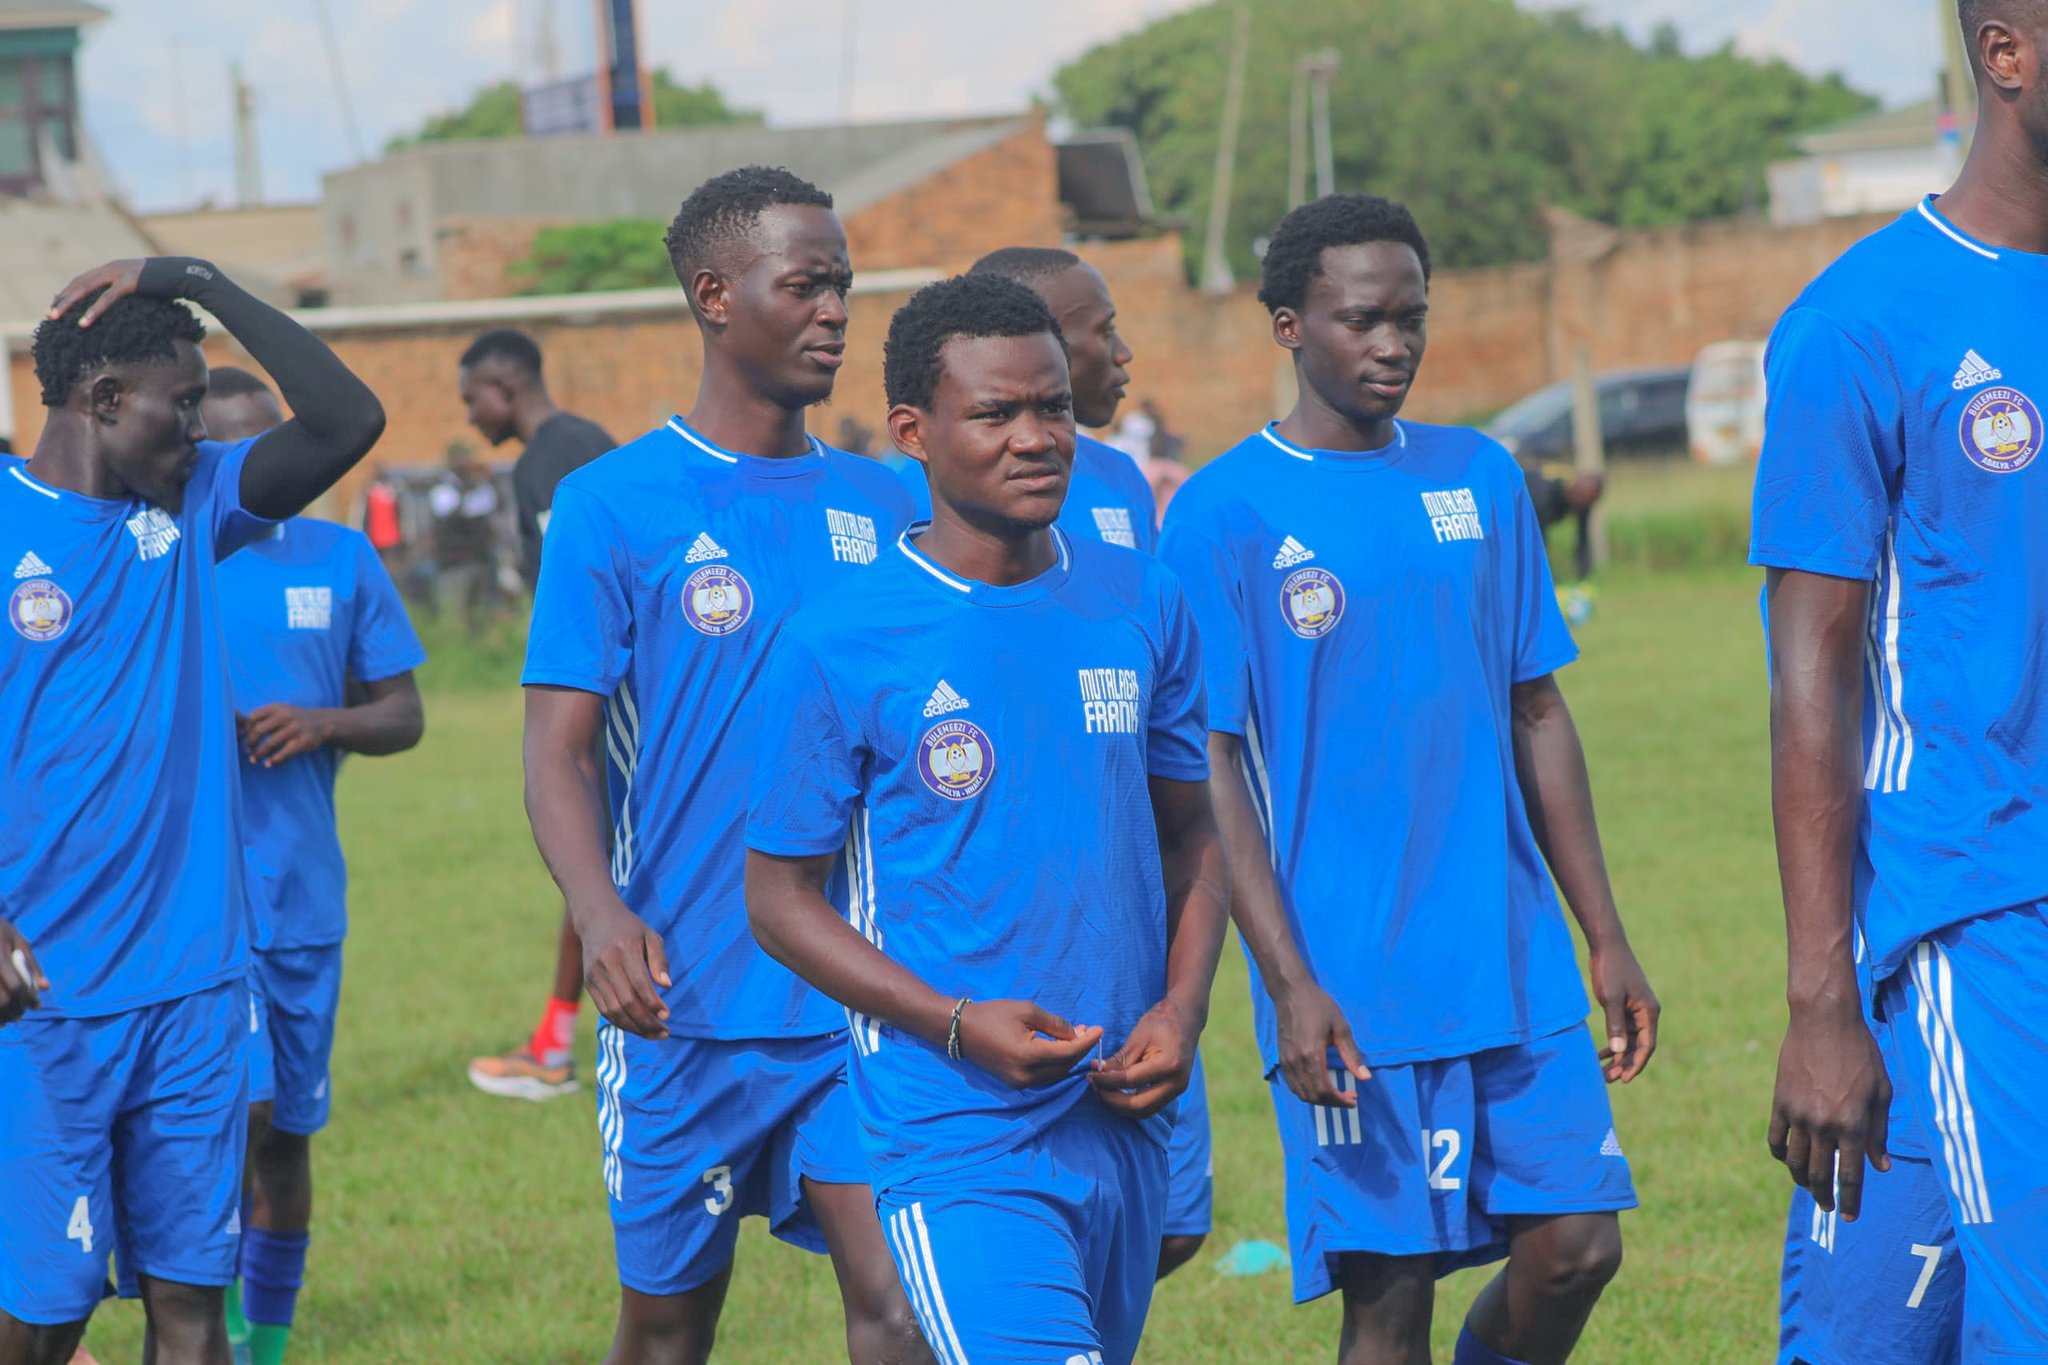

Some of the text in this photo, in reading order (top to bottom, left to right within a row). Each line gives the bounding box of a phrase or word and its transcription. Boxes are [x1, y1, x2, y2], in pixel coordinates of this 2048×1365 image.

[1952, 368, 2002, 390] adidas
[1968, 390, 2024, 416] BULEMEEZI FC
[1420, 488, 1478, 517] MUTALAGA
[826, 508, 877, 543] MUTALAGA
[1431, 513, 1484, 542] FRANK
[685, 548, 728, 563] adidas
[1273, 550, 1315, 569] adidas
[689, 567, 738, 588] BULEMEEZI FC
[1320, 573, 1330, 583] FC
[1078, 668, 1139, 701] MUTALAGA
[923, 698, 970, 718] adidas
[1084, 700, 1139, 733] FRANK
[925, 722, 979, 747] BULEMEEZI FC
[703, 1165, 734, 1216] 3
[67, 1196, 94, 1253] 4
[1906, 1243, 1943, 1308] 7
